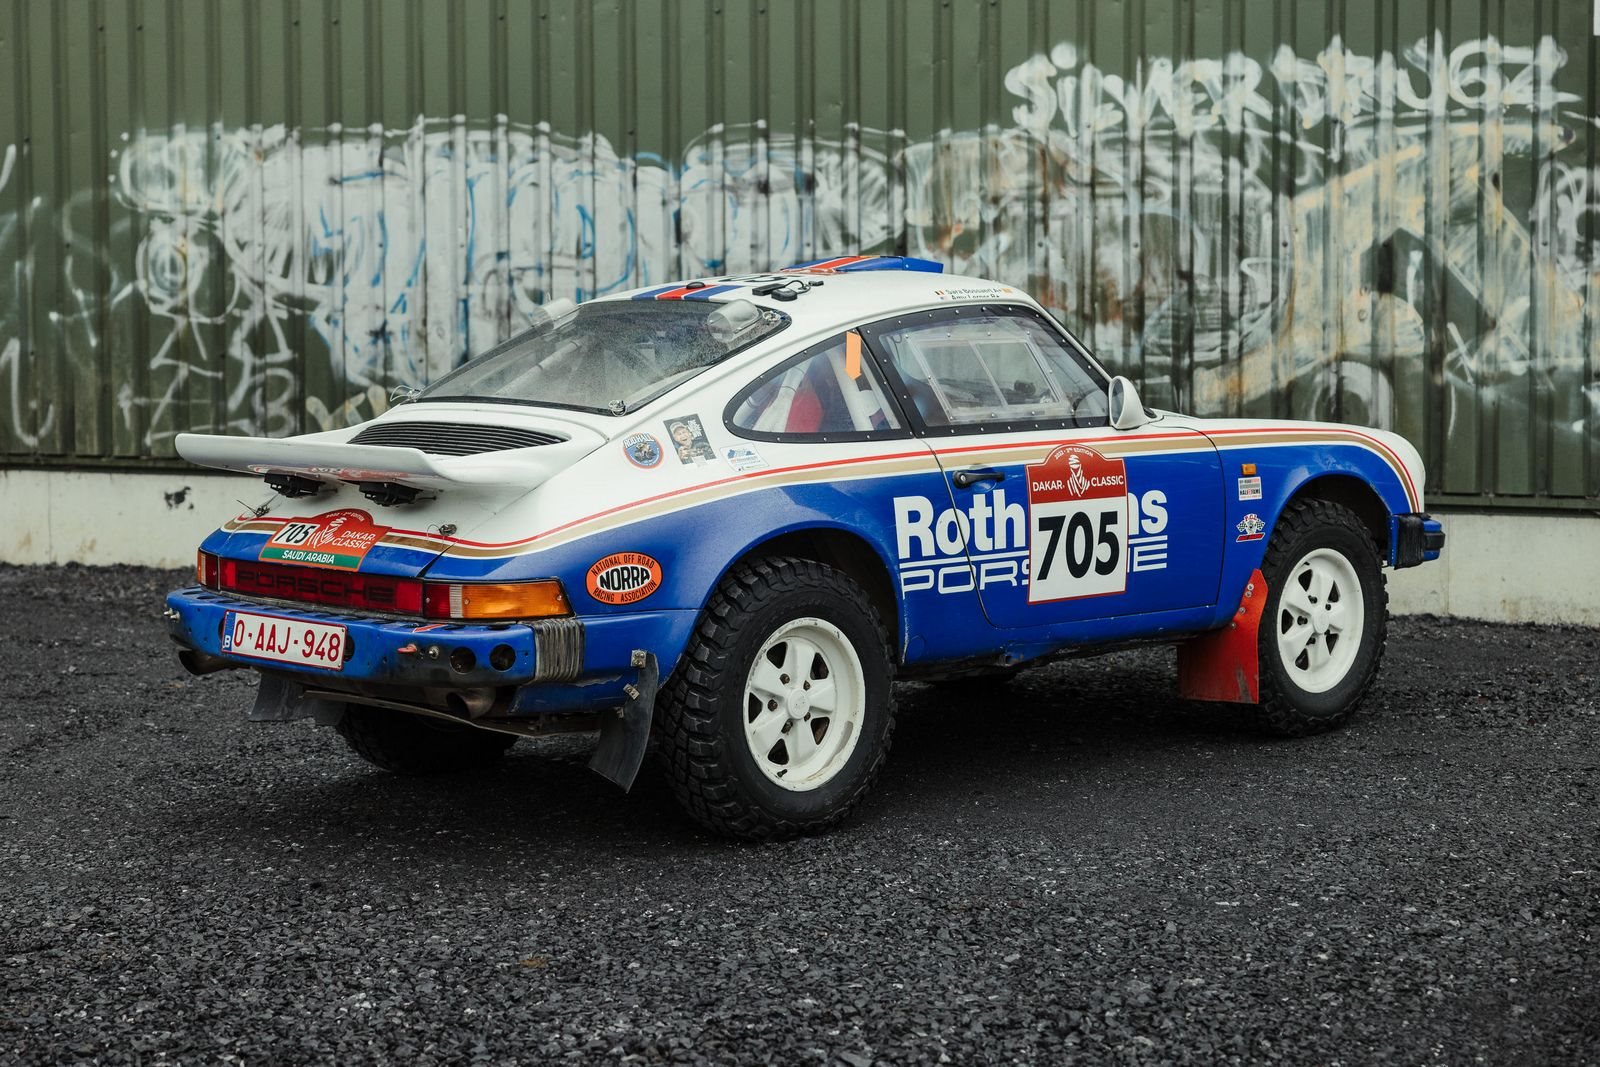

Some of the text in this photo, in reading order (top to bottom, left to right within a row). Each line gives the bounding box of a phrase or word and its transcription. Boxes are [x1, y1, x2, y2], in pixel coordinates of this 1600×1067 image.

[1032, 475, 1124, 492] DAKAR CLASSIC
[275, 523, 317, 544] 705
[341, 530, 375, 540] DAKAR
[893, 489, 1168, 560] Roths
[332, 537, 371, 549] CLASSIC
[1037, 510, 1120, 581] 705
[282, 550, 335, 564] SAUDI ARABIA
[591, 554, 655, 576] NATIONAL OFF ROAD
[599, 566, 650, 590] NORRA
[900, 543, 1168, 599] PORE
[237, 570, 395, 603] PORSCHE
[593, 580, 657, 602] RACING ASSOCIATION
[224, 635, 231, 648] B
